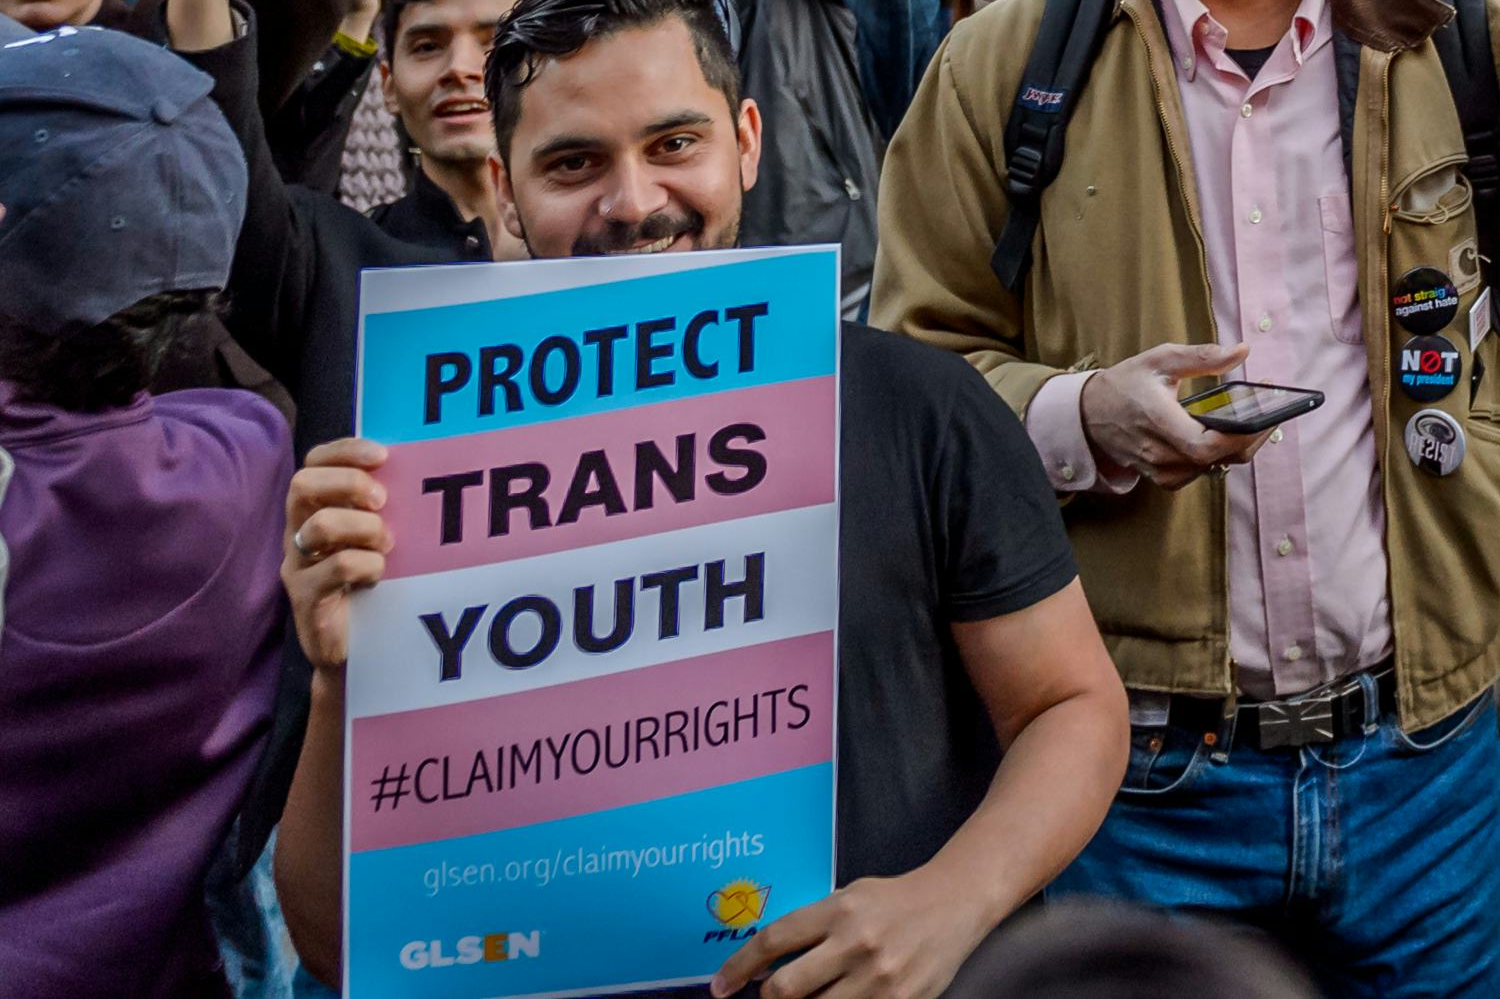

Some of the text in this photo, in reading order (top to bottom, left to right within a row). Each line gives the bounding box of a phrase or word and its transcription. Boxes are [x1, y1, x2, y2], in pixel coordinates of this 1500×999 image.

[1393, 293, 1412, 305] not
[1395, 296, 1458, 317] against hate
[423, 302, 769, 426] PROTECT
[1401, 349, 1458, 373] NOT
[421, 422, 768, 547] TRANS
[417, 551, 765, 683] YOUTH
[370, 684, 811, 812] #CLAIMYOURRIGHTS
[423, 830, 765, 897] glsen.org/claimyourrights
[399, 929, 541, 970] GLSEN
[703, 926, 758, 944] PFLA
